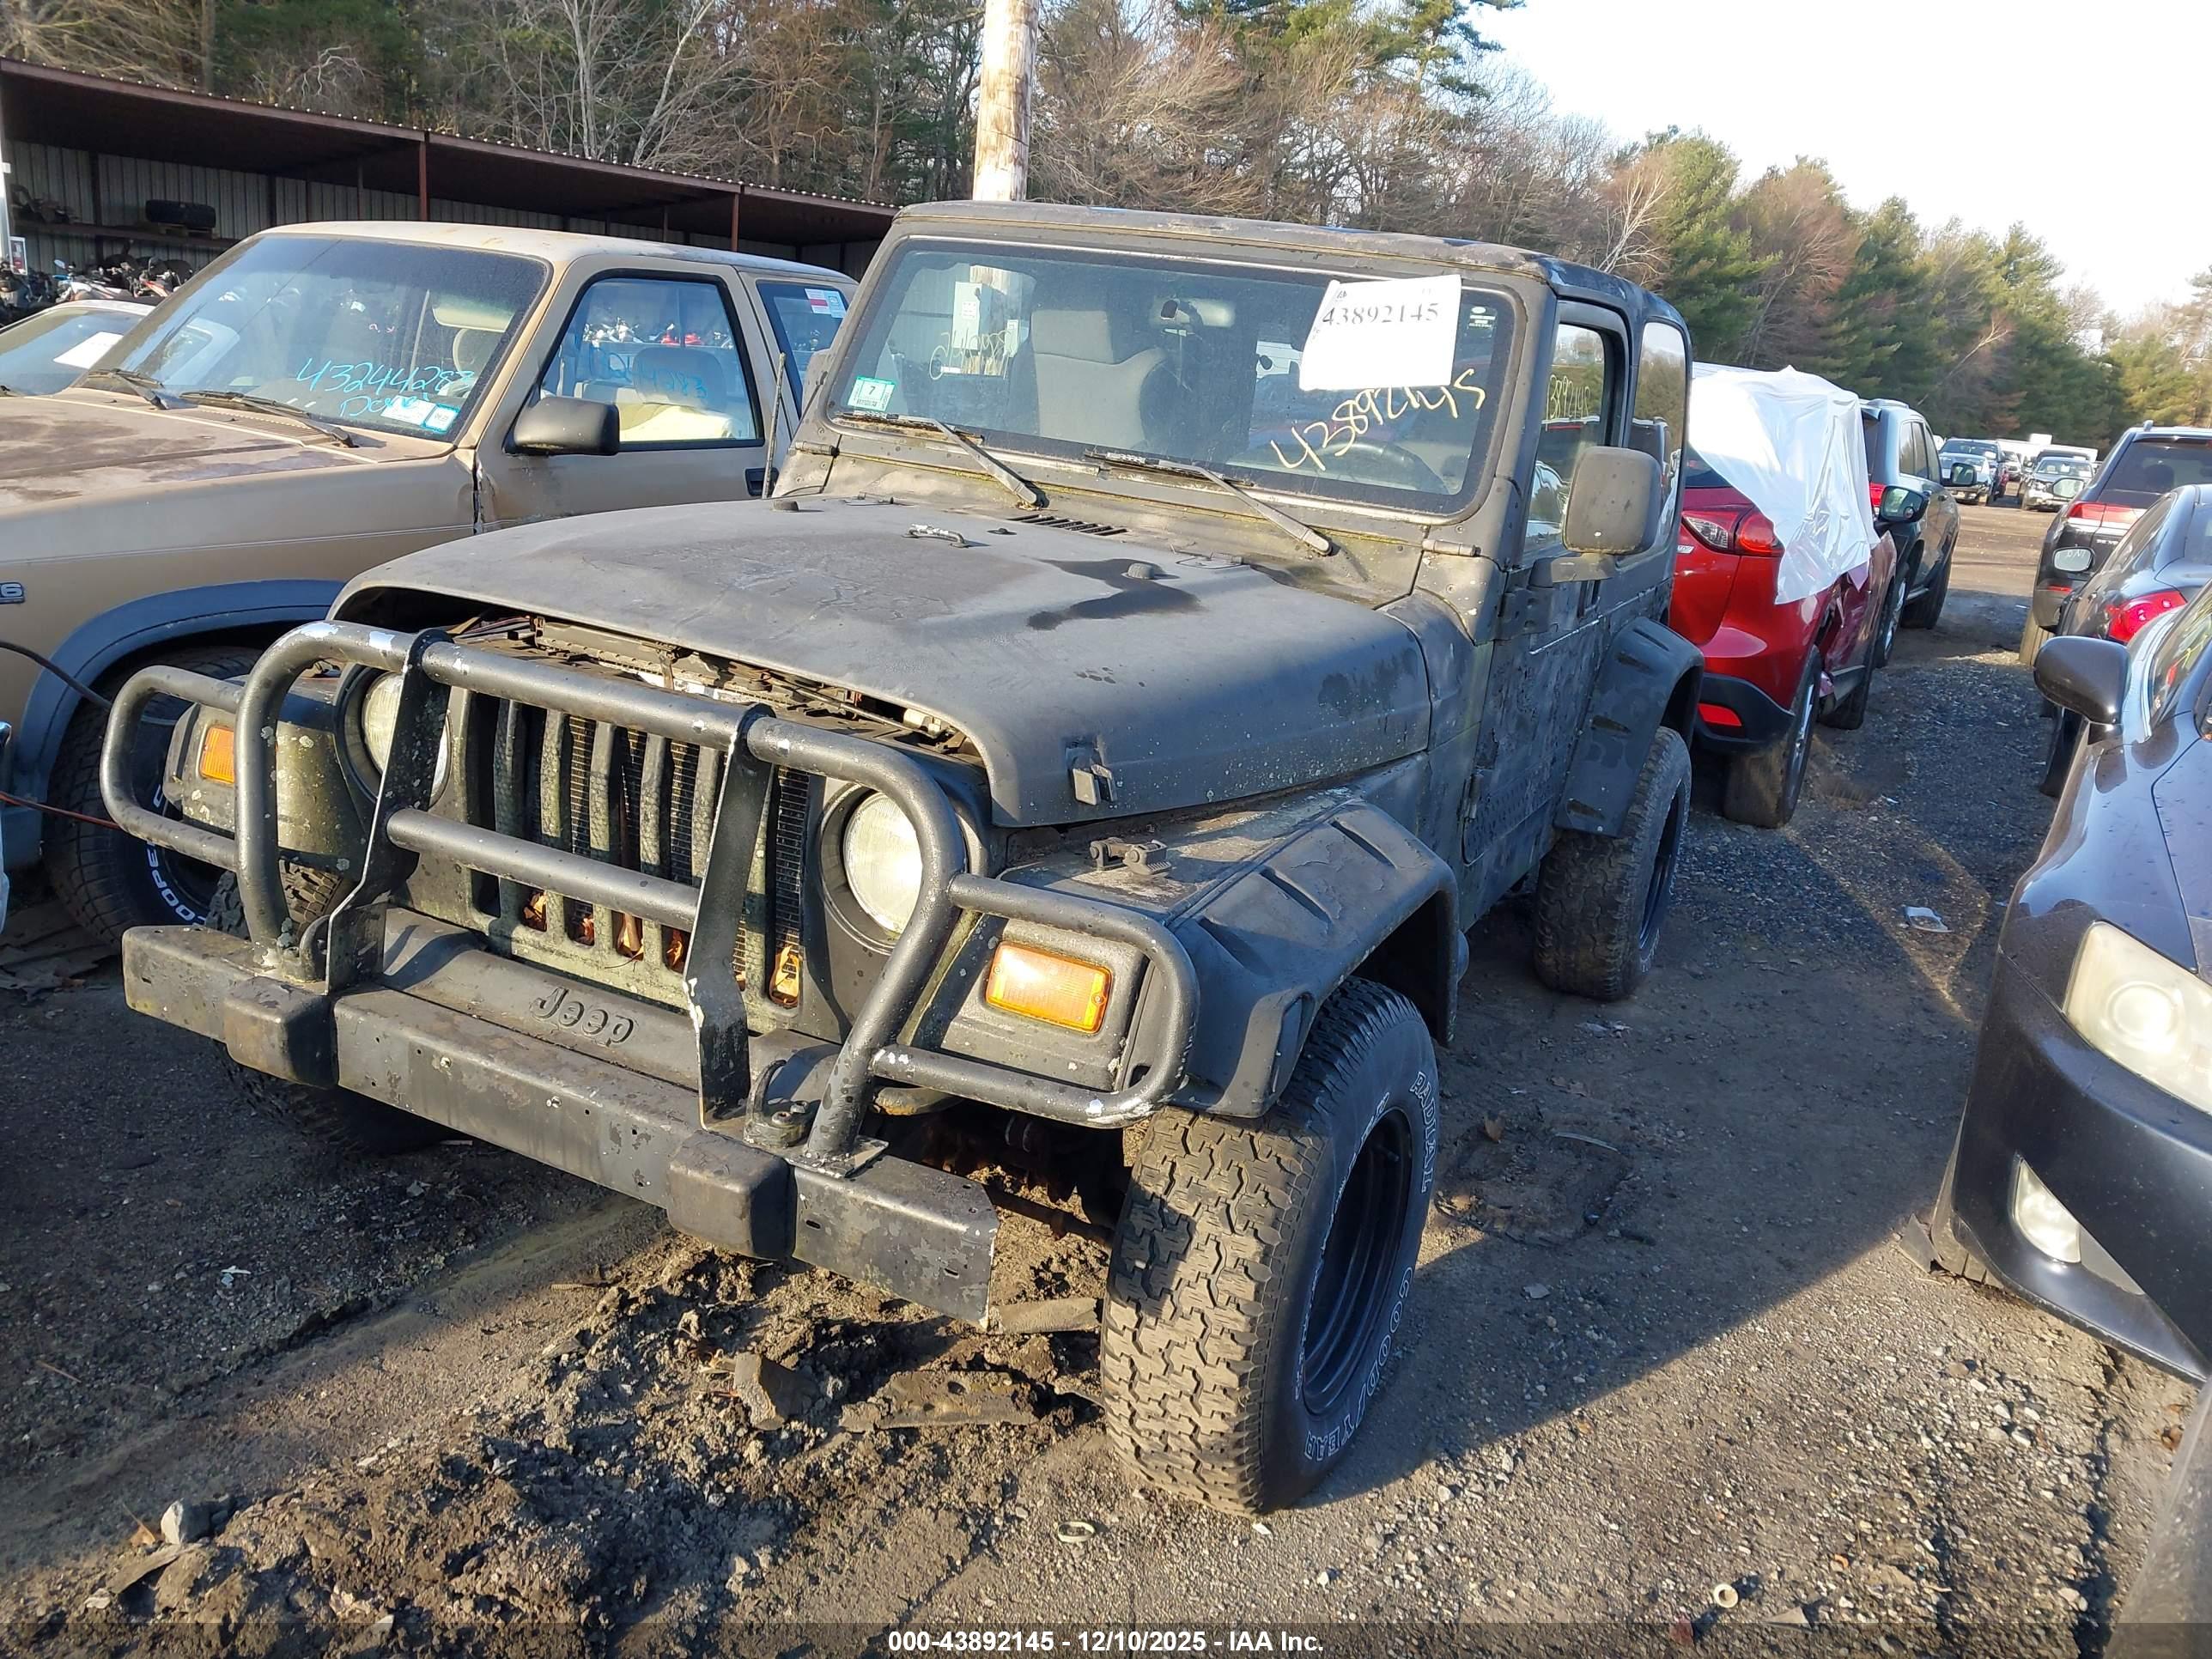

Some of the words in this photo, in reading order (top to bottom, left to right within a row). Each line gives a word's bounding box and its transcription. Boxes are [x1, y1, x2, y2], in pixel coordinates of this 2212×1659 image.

[1322, 302, 1440, 325] 43892145
[296, 358, 475, 396] 43244283
[147, 841, 207, 927] COOPE
[529, 986, 634, 1047] Jeep
[1409, 1071, 1437, 1194] RADIAL
